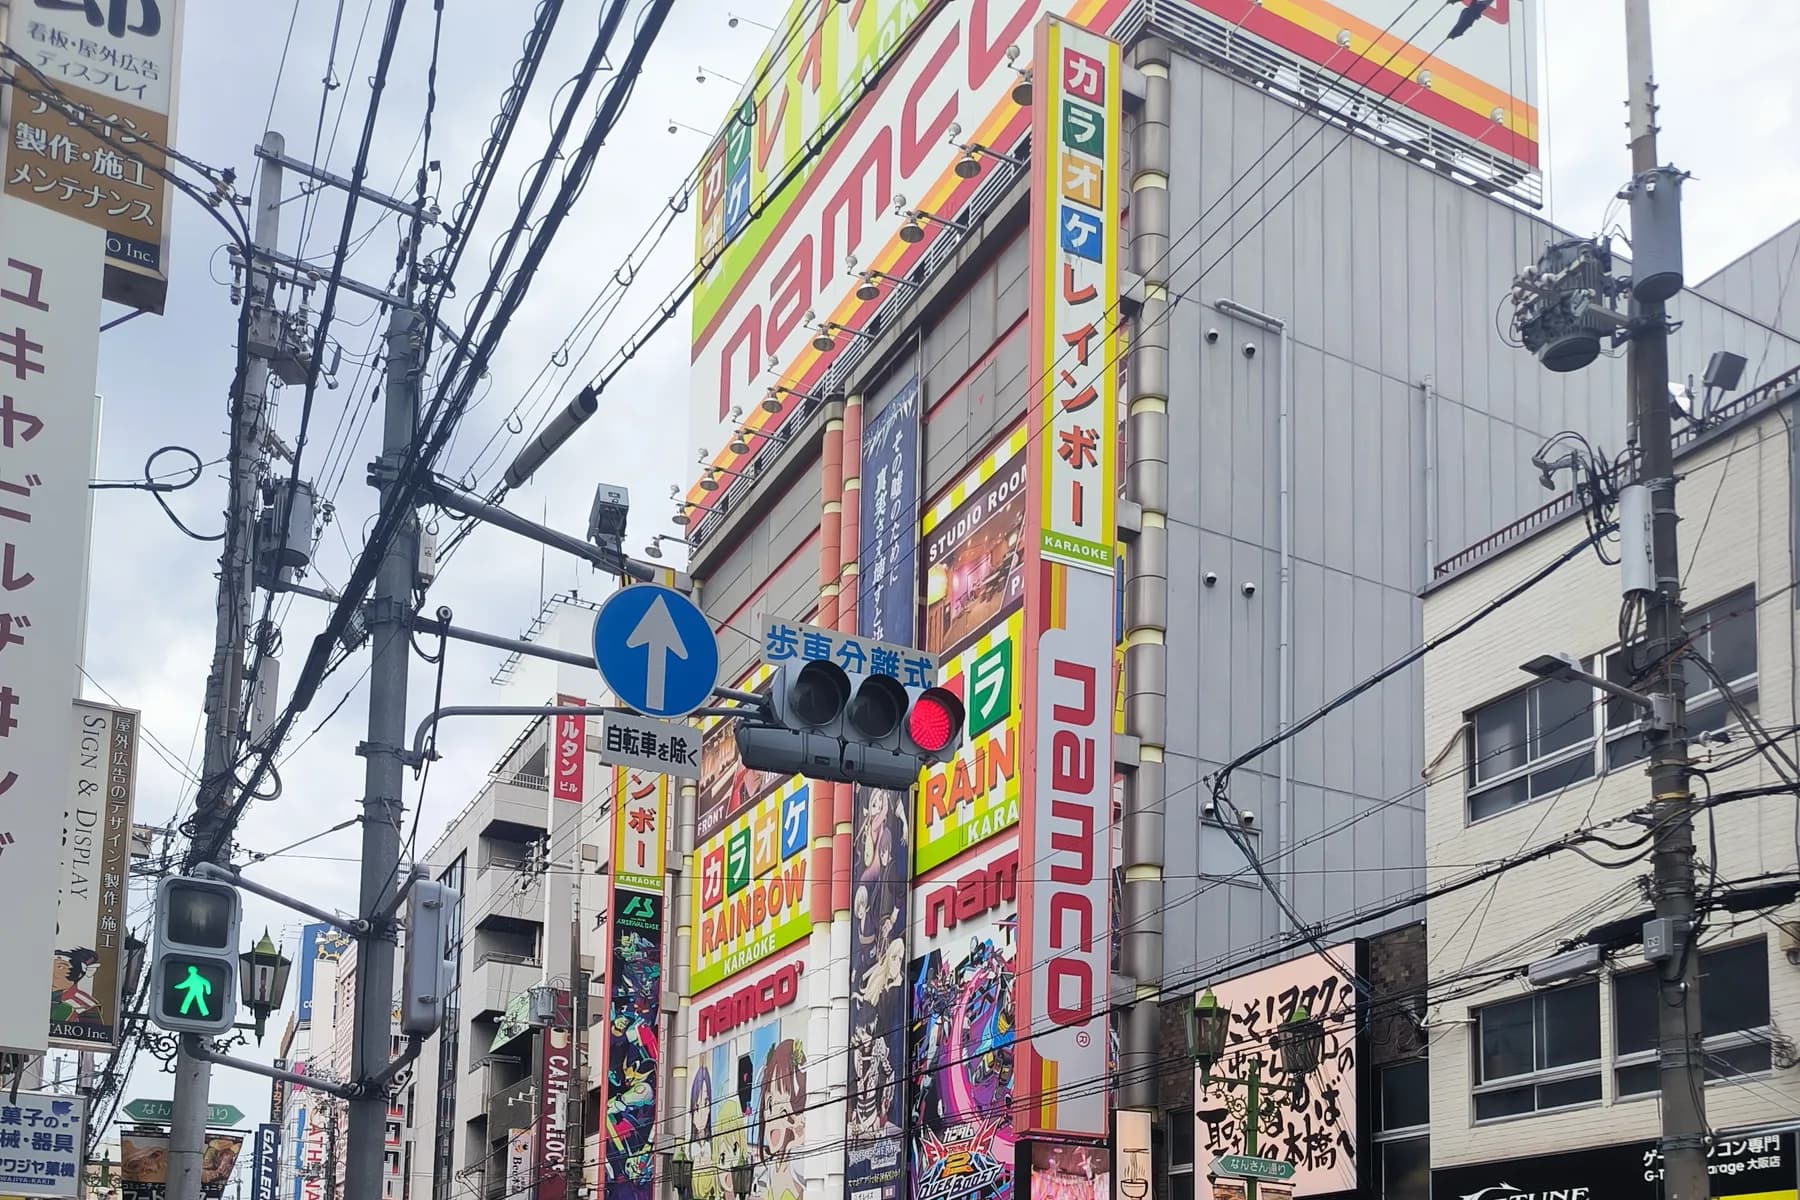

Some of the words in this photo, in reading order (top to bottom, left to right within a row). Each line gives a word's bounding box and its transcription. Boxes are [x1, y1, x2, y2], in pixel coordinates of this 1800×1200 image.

[27, 20, 160, 81] 看板・屋外広告
[36, 51, 149, 101] ディスプレイ
[8, 163, 154, 227] メンテナンス
[928, 504, 982, 563] STUDIO
[1044, 535, 1108, 561] KARAOKE
[766, 624, 932, 690] 歩車分離式
[80, 714, 107, 769] SIGN
[560, 698, 580, 777] ルタン
[606, 724, 699, 767] 自転車を除く
[697, 804, 725, 837] FRONT
[703, 797, 807, 902] カラオケ
[1047, 659, 1097, 1028] namco
[701, 857, 807, 958] RAINBOW
[722, 931, 776, 977] KARAOKE
[698, 964, 800, 1041] namco
[0, 1158, 76, 1178] ワジヤ菓機
[1746, 1155, 1781, 1171] 大阪店
